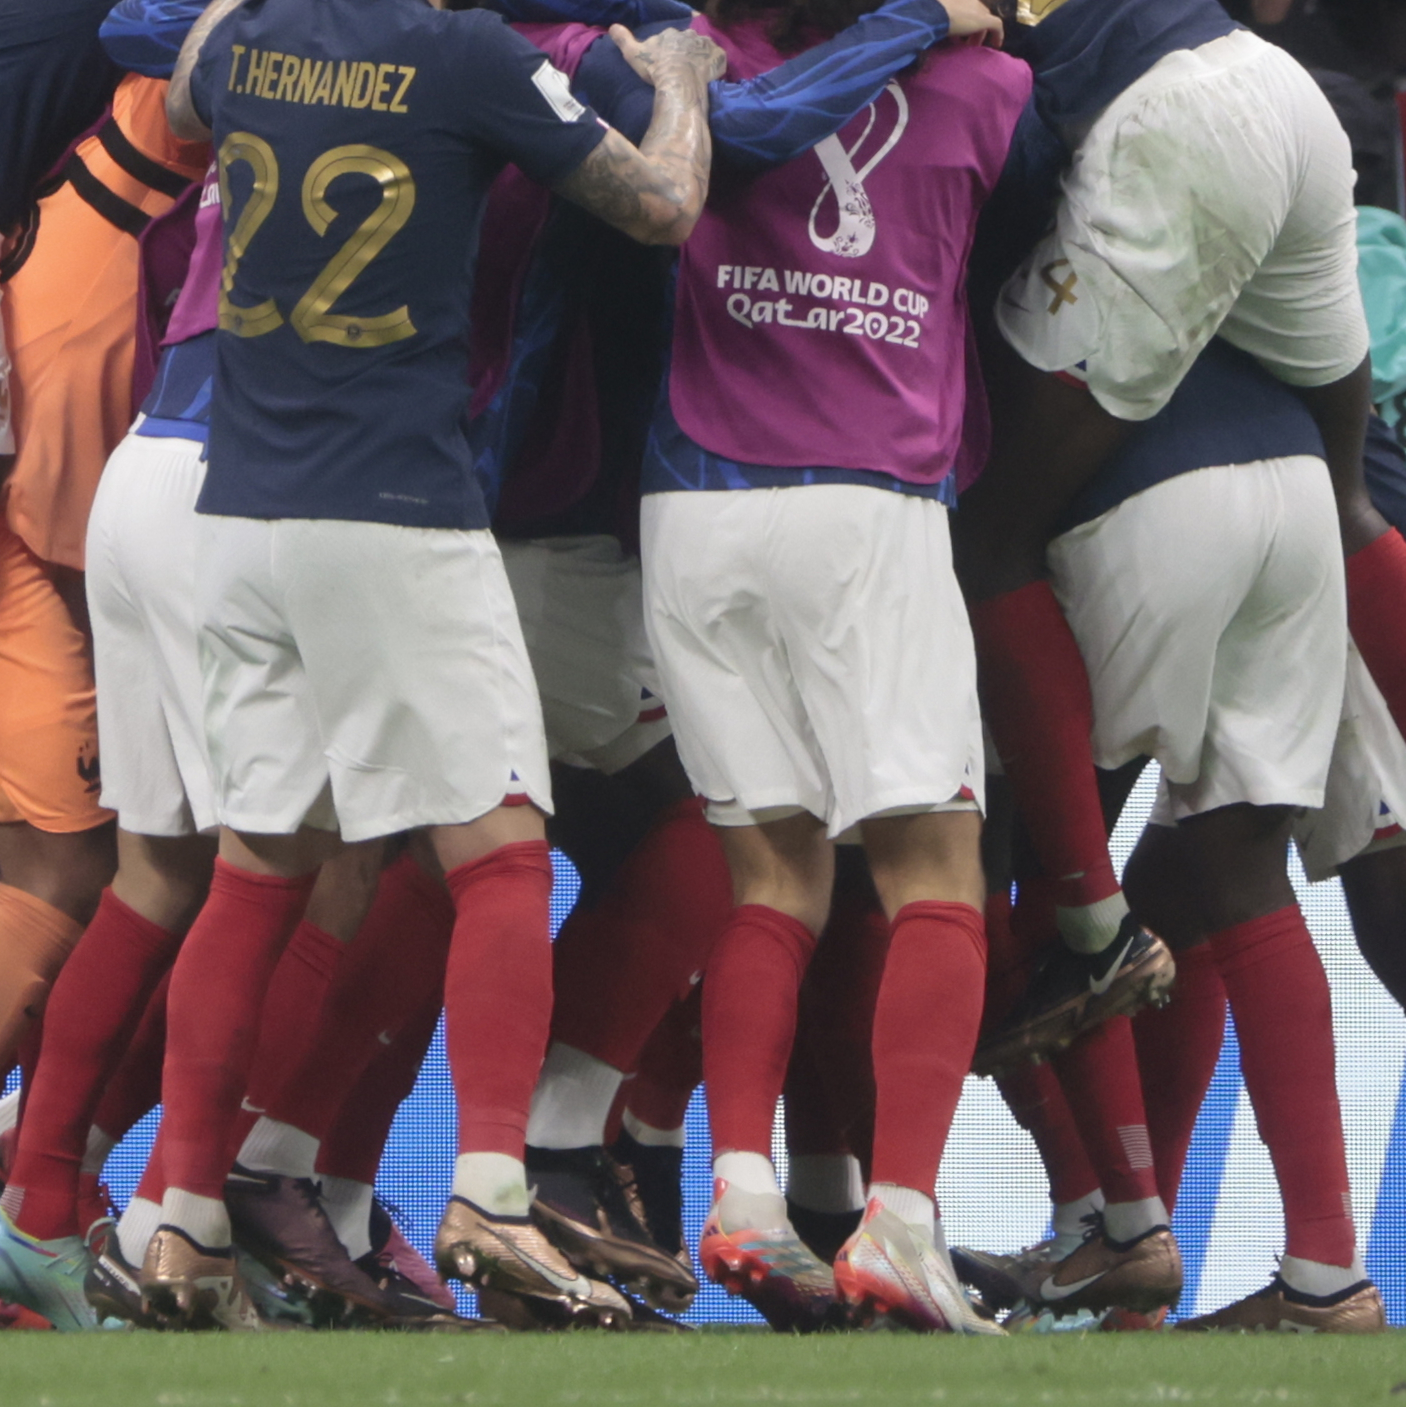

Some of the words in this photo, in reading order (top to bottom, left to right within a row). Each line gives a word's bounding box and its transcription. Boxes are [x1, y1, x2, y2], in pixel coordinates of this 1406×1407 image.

[228, 44, 417, 114] T.HERNANDEZ
[217, 131, 418, 349] 22
[716, 264, 780, 292] FIFA
[783, 269, 890, 307] WORLD
[892, 287, 930, 319] CUP
